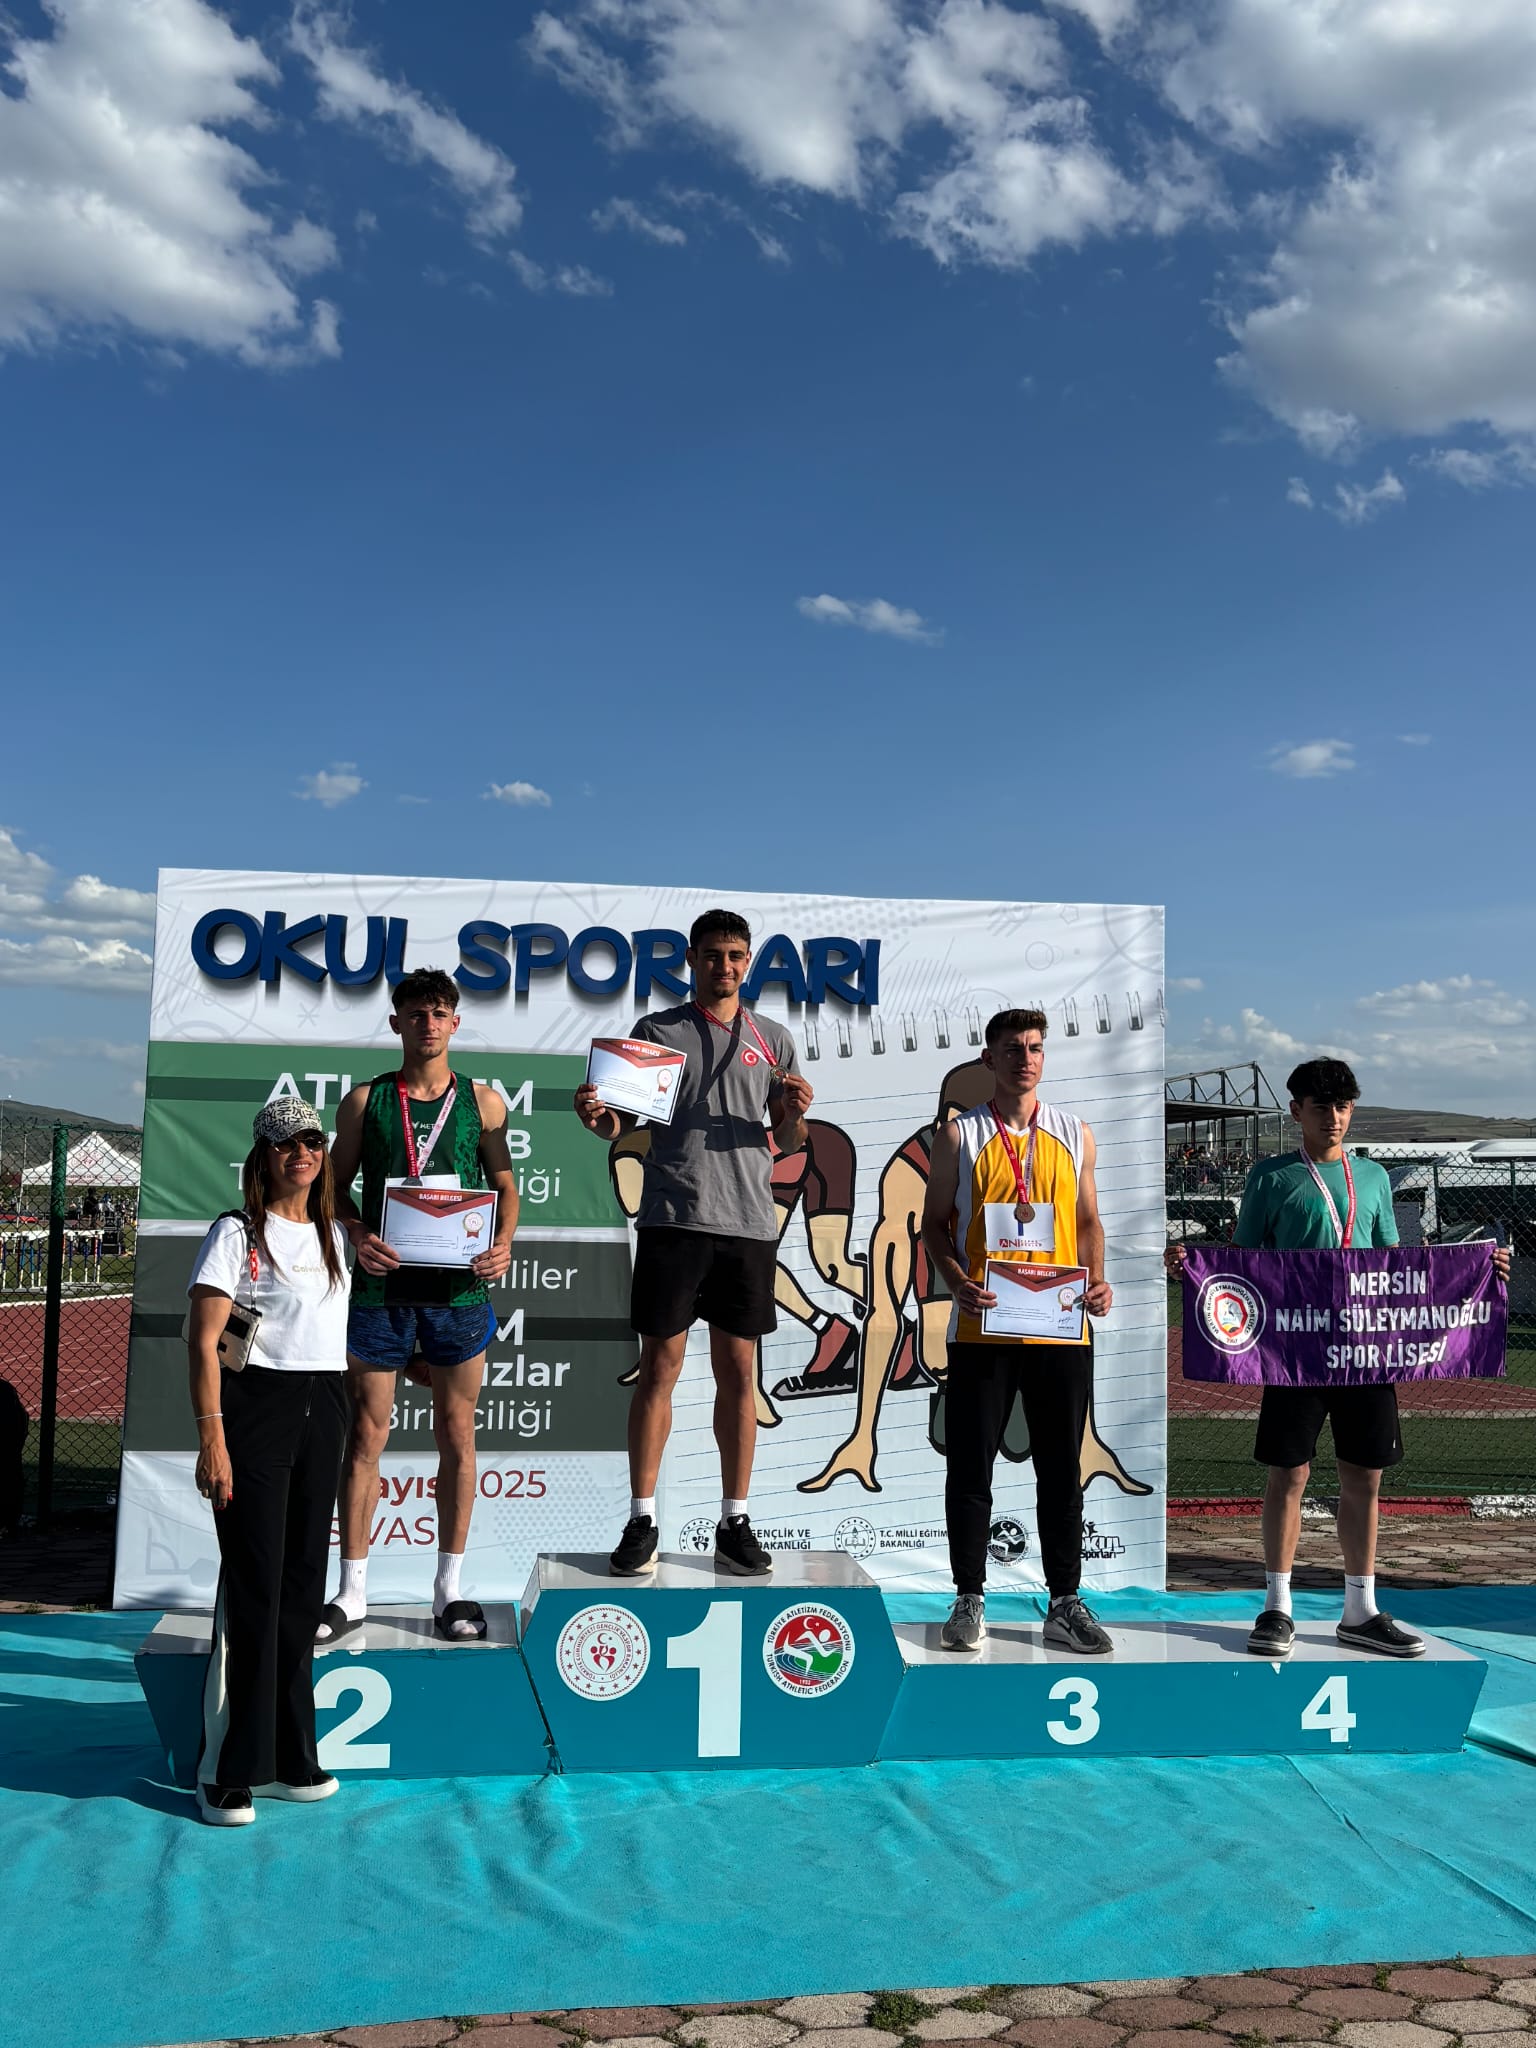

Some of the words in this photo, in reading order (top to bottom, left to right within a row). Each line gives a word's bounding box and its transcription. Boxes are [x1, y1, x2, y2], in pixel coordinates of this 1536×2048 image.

[191, 908, 408, 986] OKUL
[453, 919, 881, 1006] SPORARI
[1350, 1266, 1427, 1296] MERSİN
[1275, 1304, 1331, 1333] NAİM
[1338, 1298, 1492, 1333] SÜLEYMANOĞLU
[1326, 1344, 1380, 1369] SPOR
[1386, 1335, 1448, 1368] LİSESİ
[476, 1470, 547, 1499] 025
[797, 1529, 811, 1538] VE
[880, 1530, 894, 1538] T.C.
[896, 1529, 917, 1538] MİLLİ
[880, 1539, 925, 1548] BAKANLIĞI
[767, 1617, 786, 1644] TÜRKİYE
[786, 1606, 818, 1619] ATLETİZM
[819, 1608, 852, 1651] FEDERASYONU
[666, 1601, 743, 1757] 1
[314, 1666, 392, 1770] 2
[1046, 1676, 1100, 1746] 3
[1301, 1675, 1357, 1743] 4
